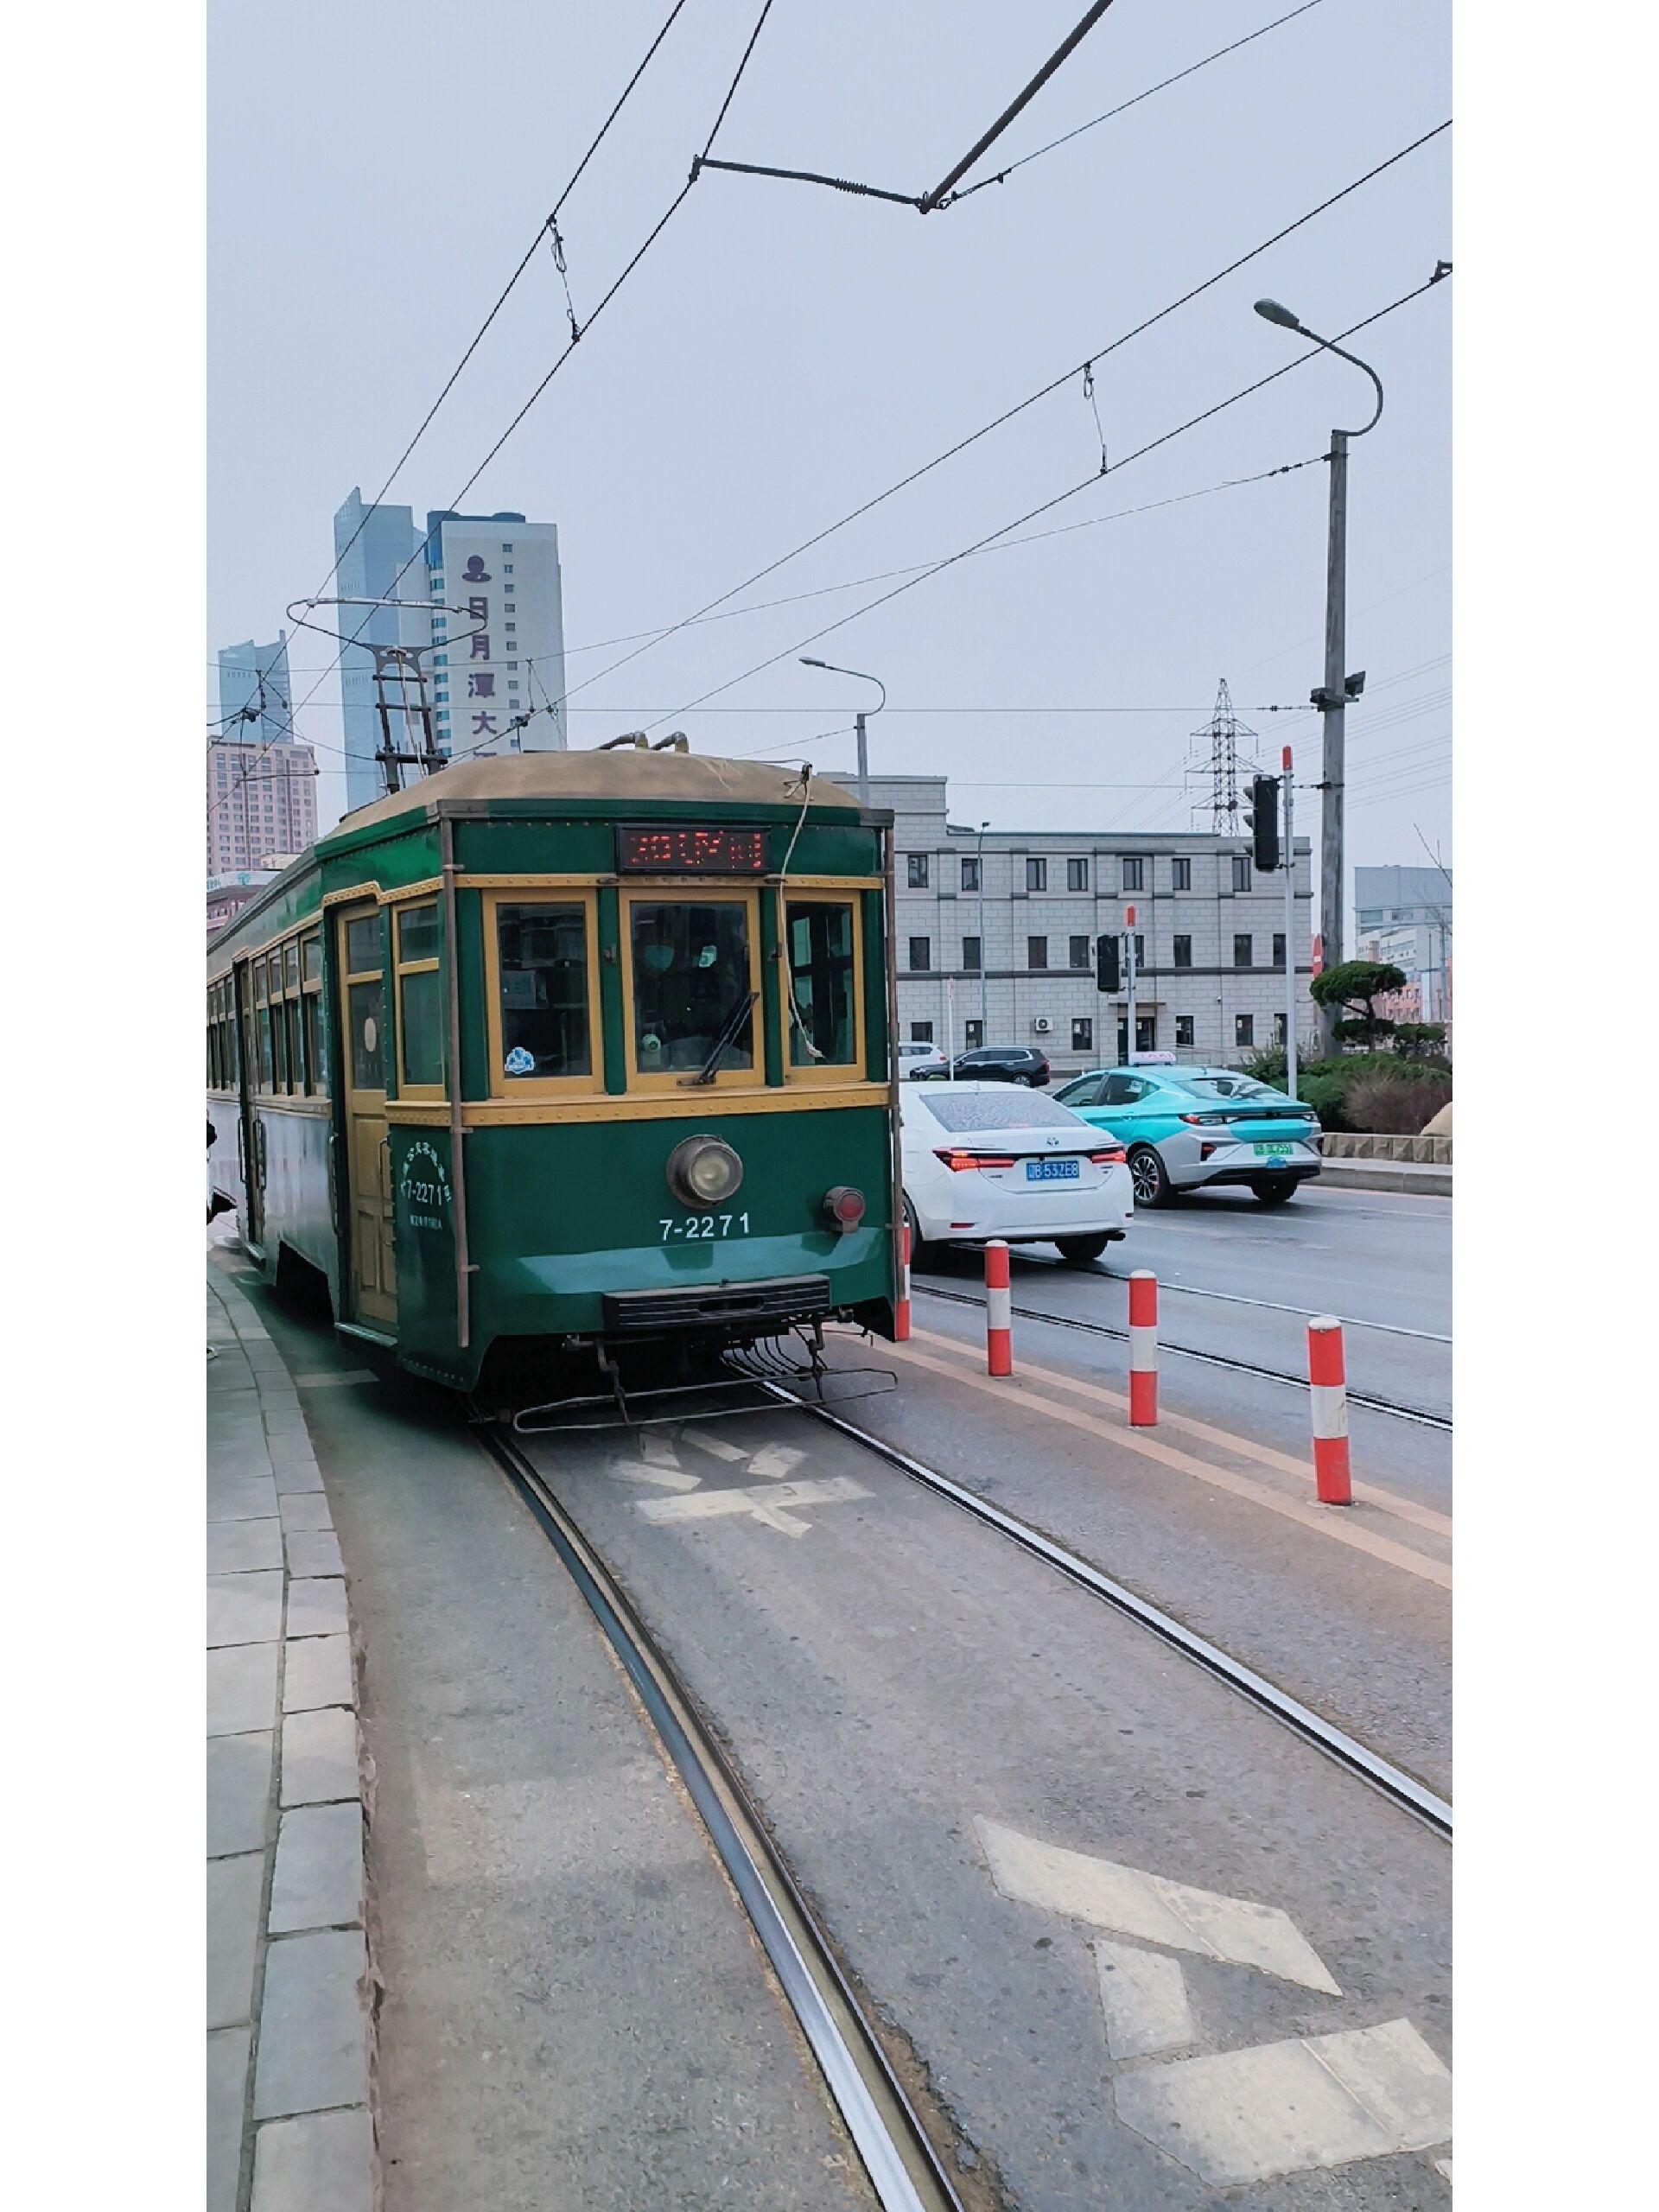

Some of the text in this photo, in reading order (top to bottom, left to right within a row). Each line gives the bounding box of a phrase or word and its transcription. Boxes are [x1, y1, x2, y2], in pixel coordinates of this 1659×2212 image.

[468, 596, 498, 757] 日月潭大
[407, 1179, 442, 1205] 7-2271
[659, 1212, 750, 1241] 7-2271
